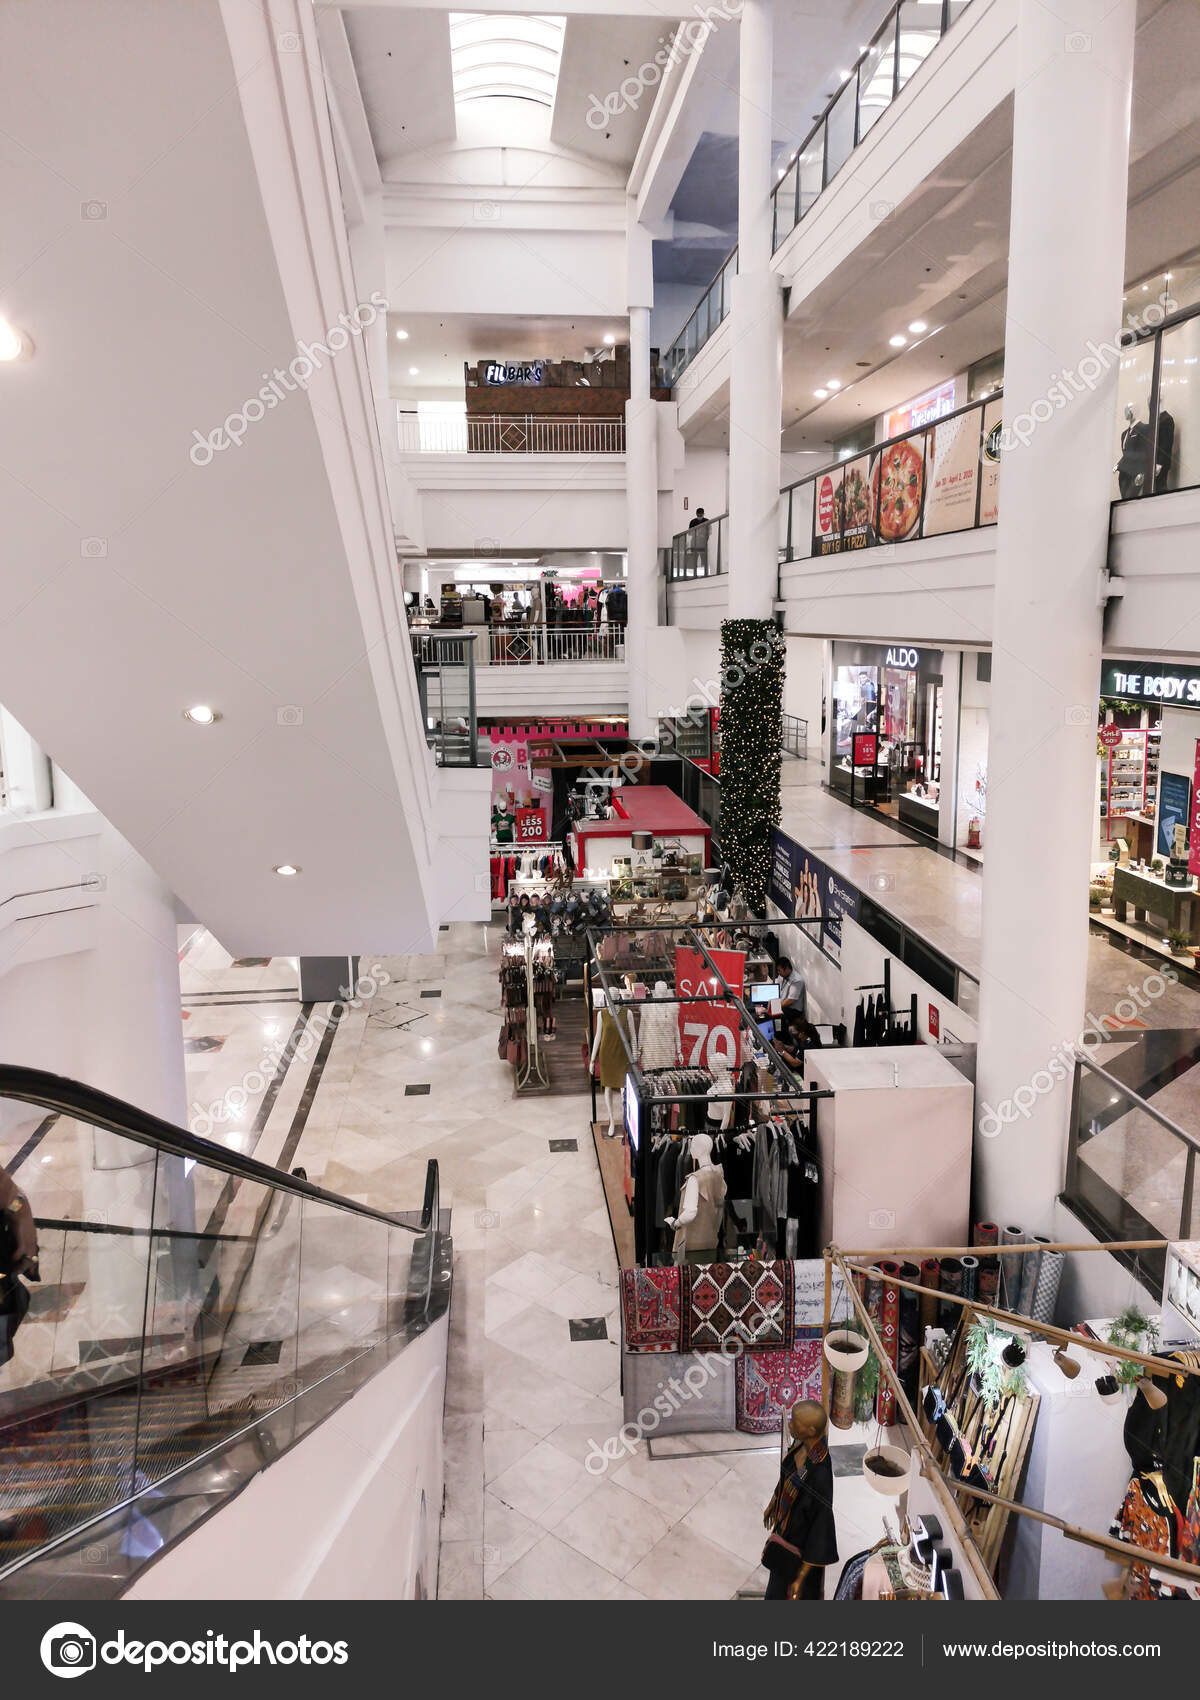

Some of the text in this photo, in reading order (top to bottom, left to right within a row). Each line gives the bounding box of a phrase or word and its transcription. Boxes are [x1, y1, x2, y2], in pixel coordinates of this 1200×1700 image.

[851, 535, 867, 548] PIZZA
[886, 648, 918, 668] ALDO
[1114, 672, 1141, 694] THE
[1143, 675, 1187, 699] BODY
[521, 818, 542, 827] LESS
[521, 827, 542, 837] 200
[680, 979, 739, 1009] SALE
[684, 1022, 737, 1080] 70
